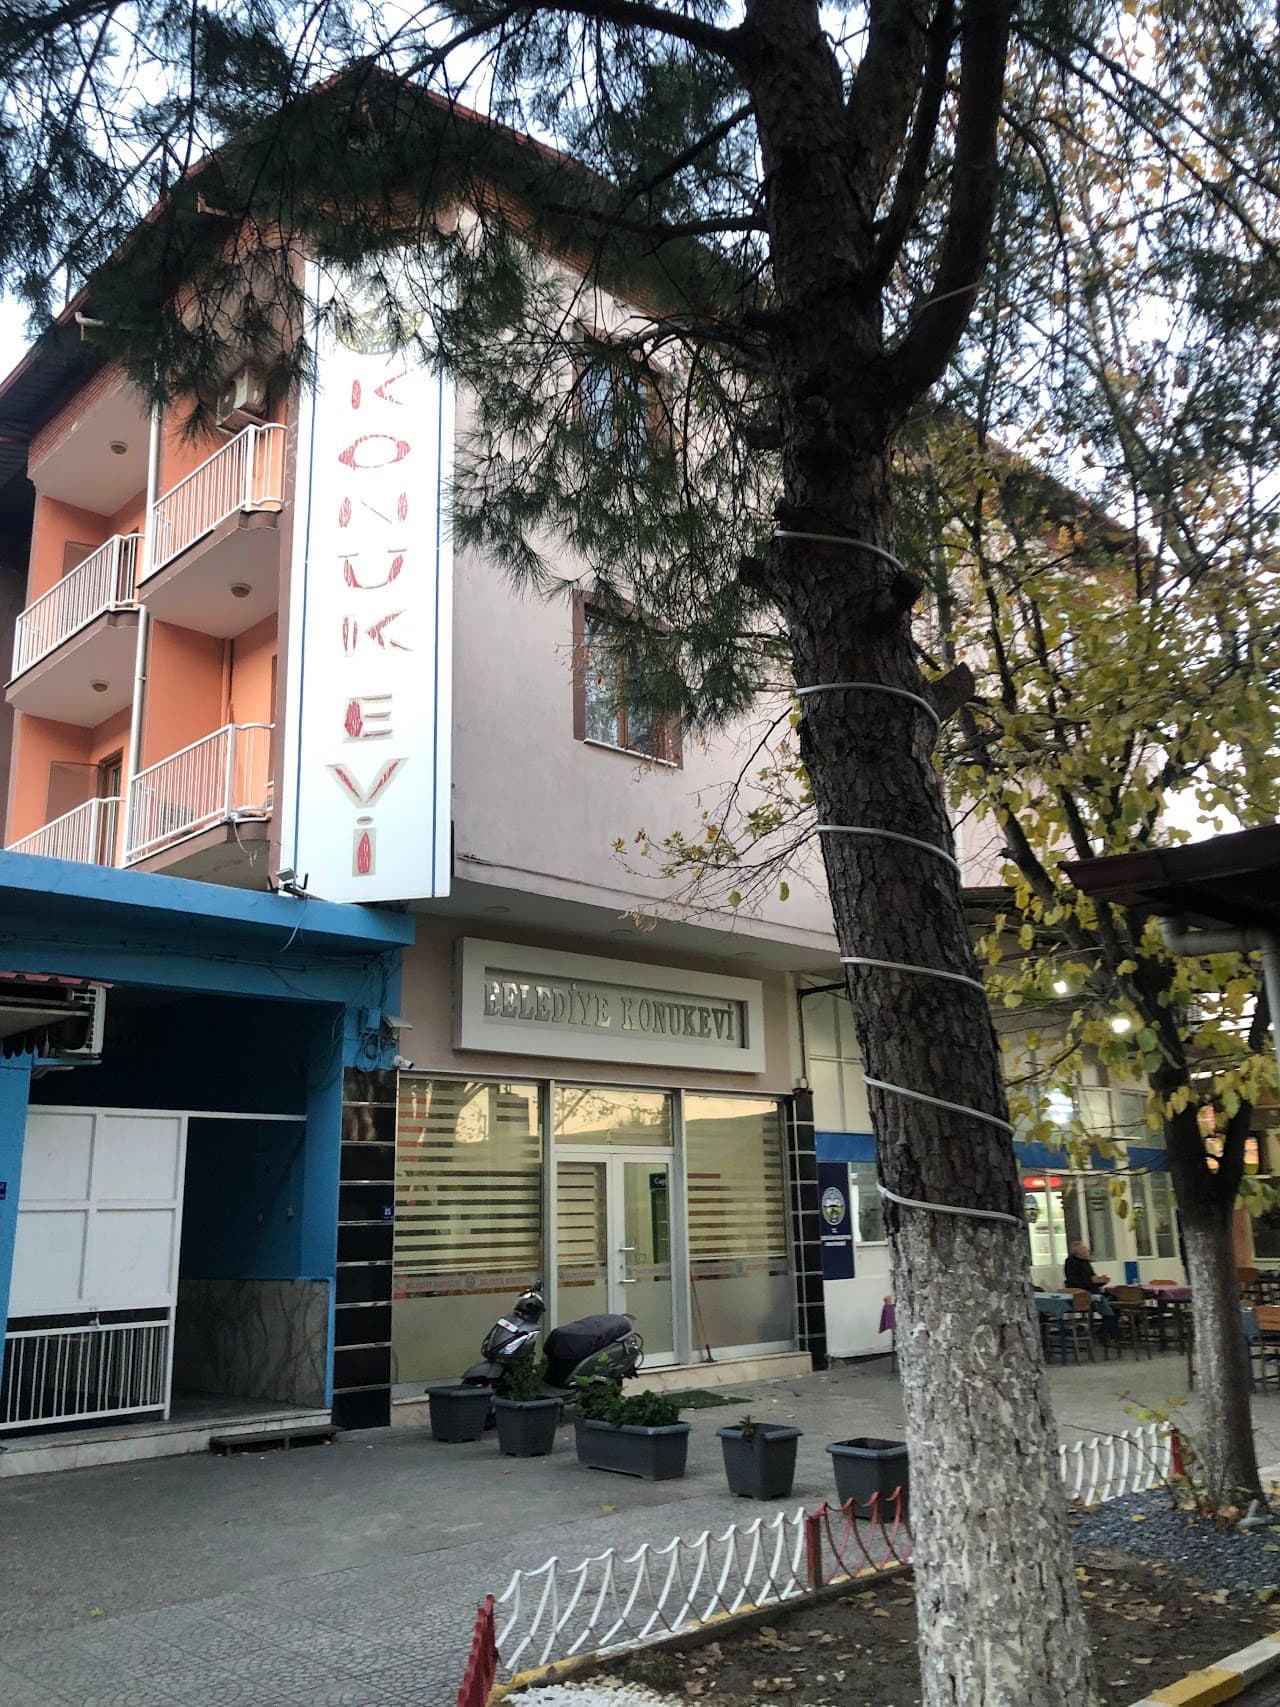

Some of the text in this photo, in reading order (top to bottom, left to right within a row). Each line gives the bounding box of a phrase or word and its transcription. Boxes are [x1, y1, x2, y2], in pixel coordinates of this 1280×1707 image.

[324, 367, 411, 877] KONUKEVİ
[483, 980, 735, 1041] BELEDİYE KONUKEVİ
